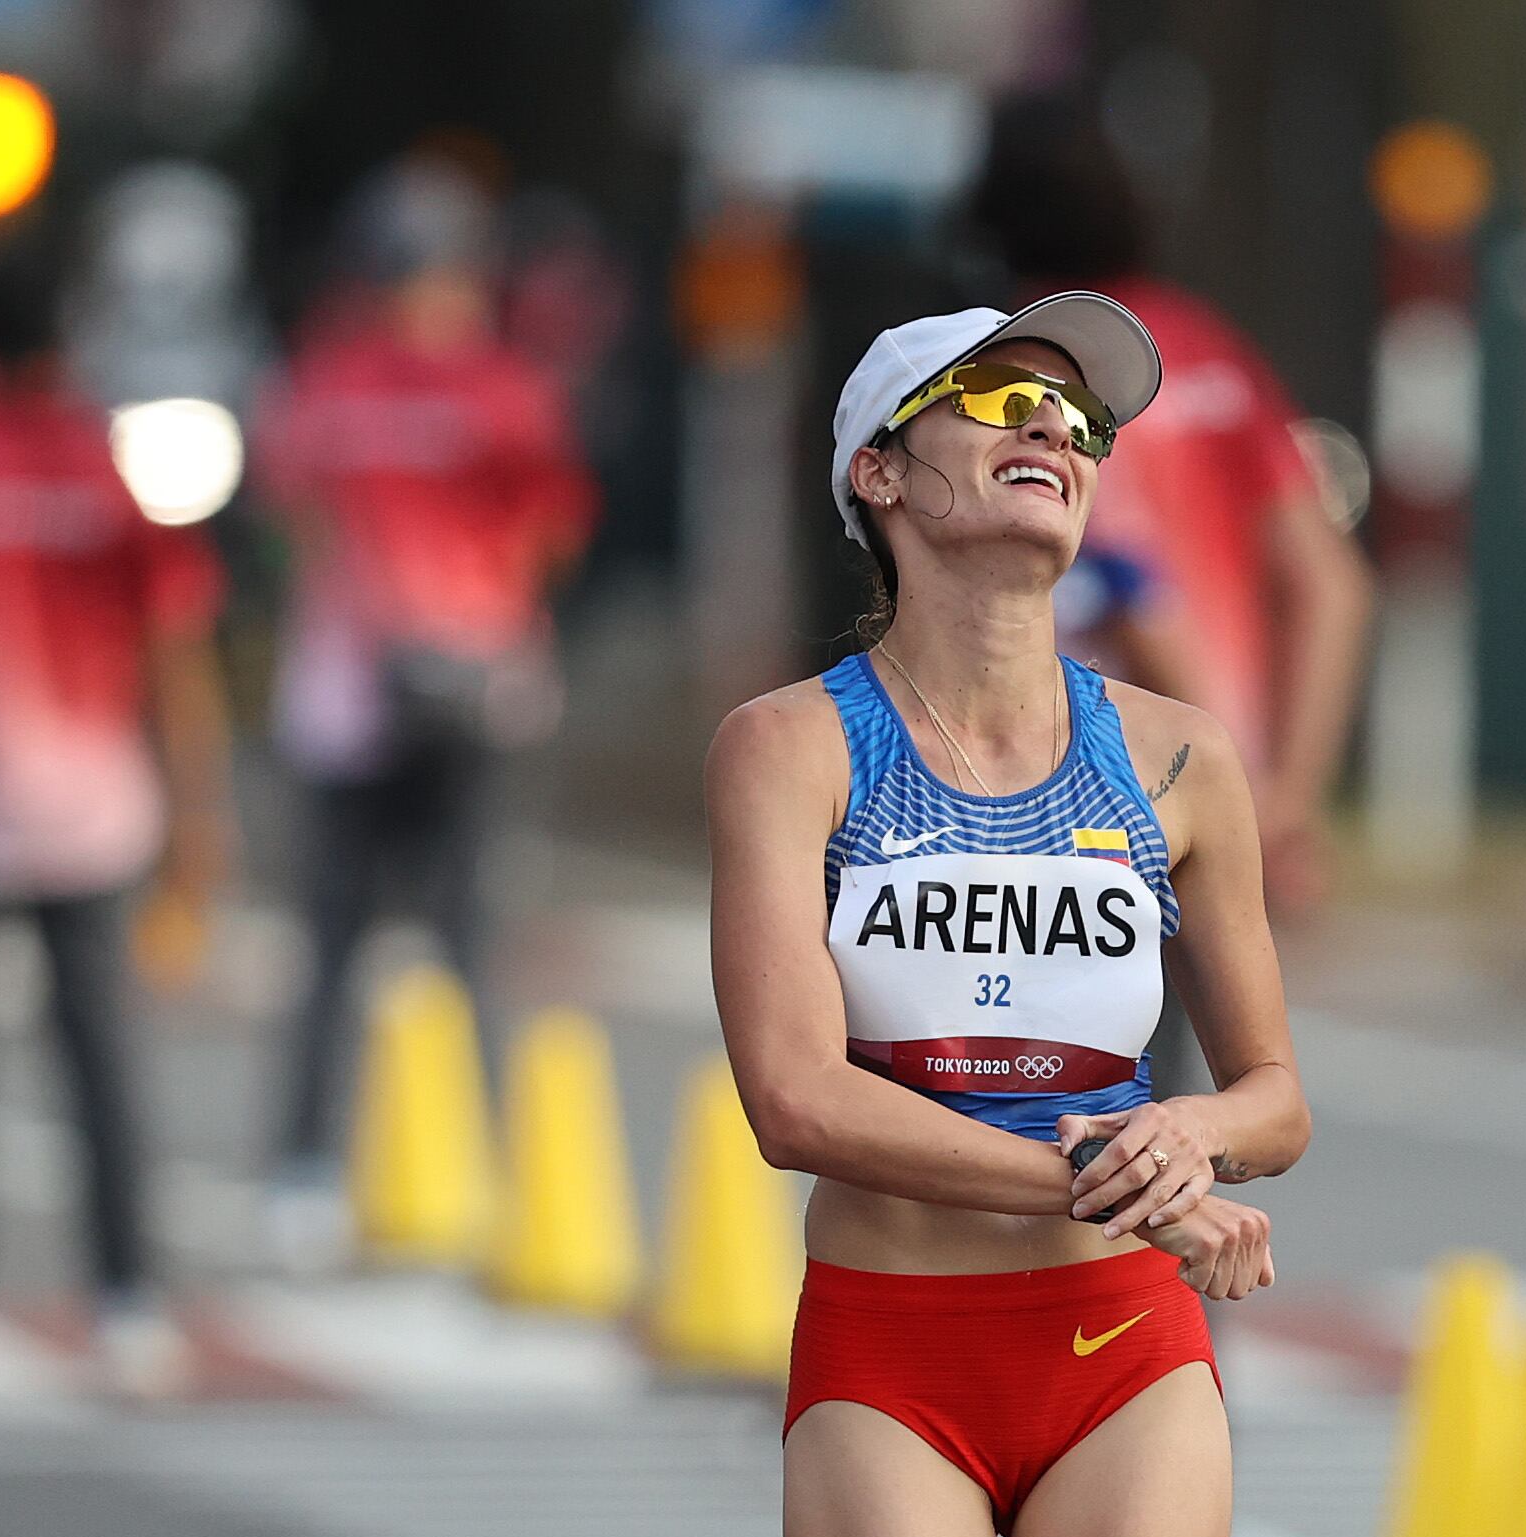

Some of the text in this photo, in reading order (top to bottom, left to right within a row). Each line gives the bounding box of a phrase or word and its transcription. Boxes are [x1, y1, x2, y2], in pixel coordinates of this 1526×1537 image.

[856, 881, 1137, 957] ARENAS
[974, 974, 1011, 1007] 32
[925, 1057, 1010, 1074] TOKYO 2020
